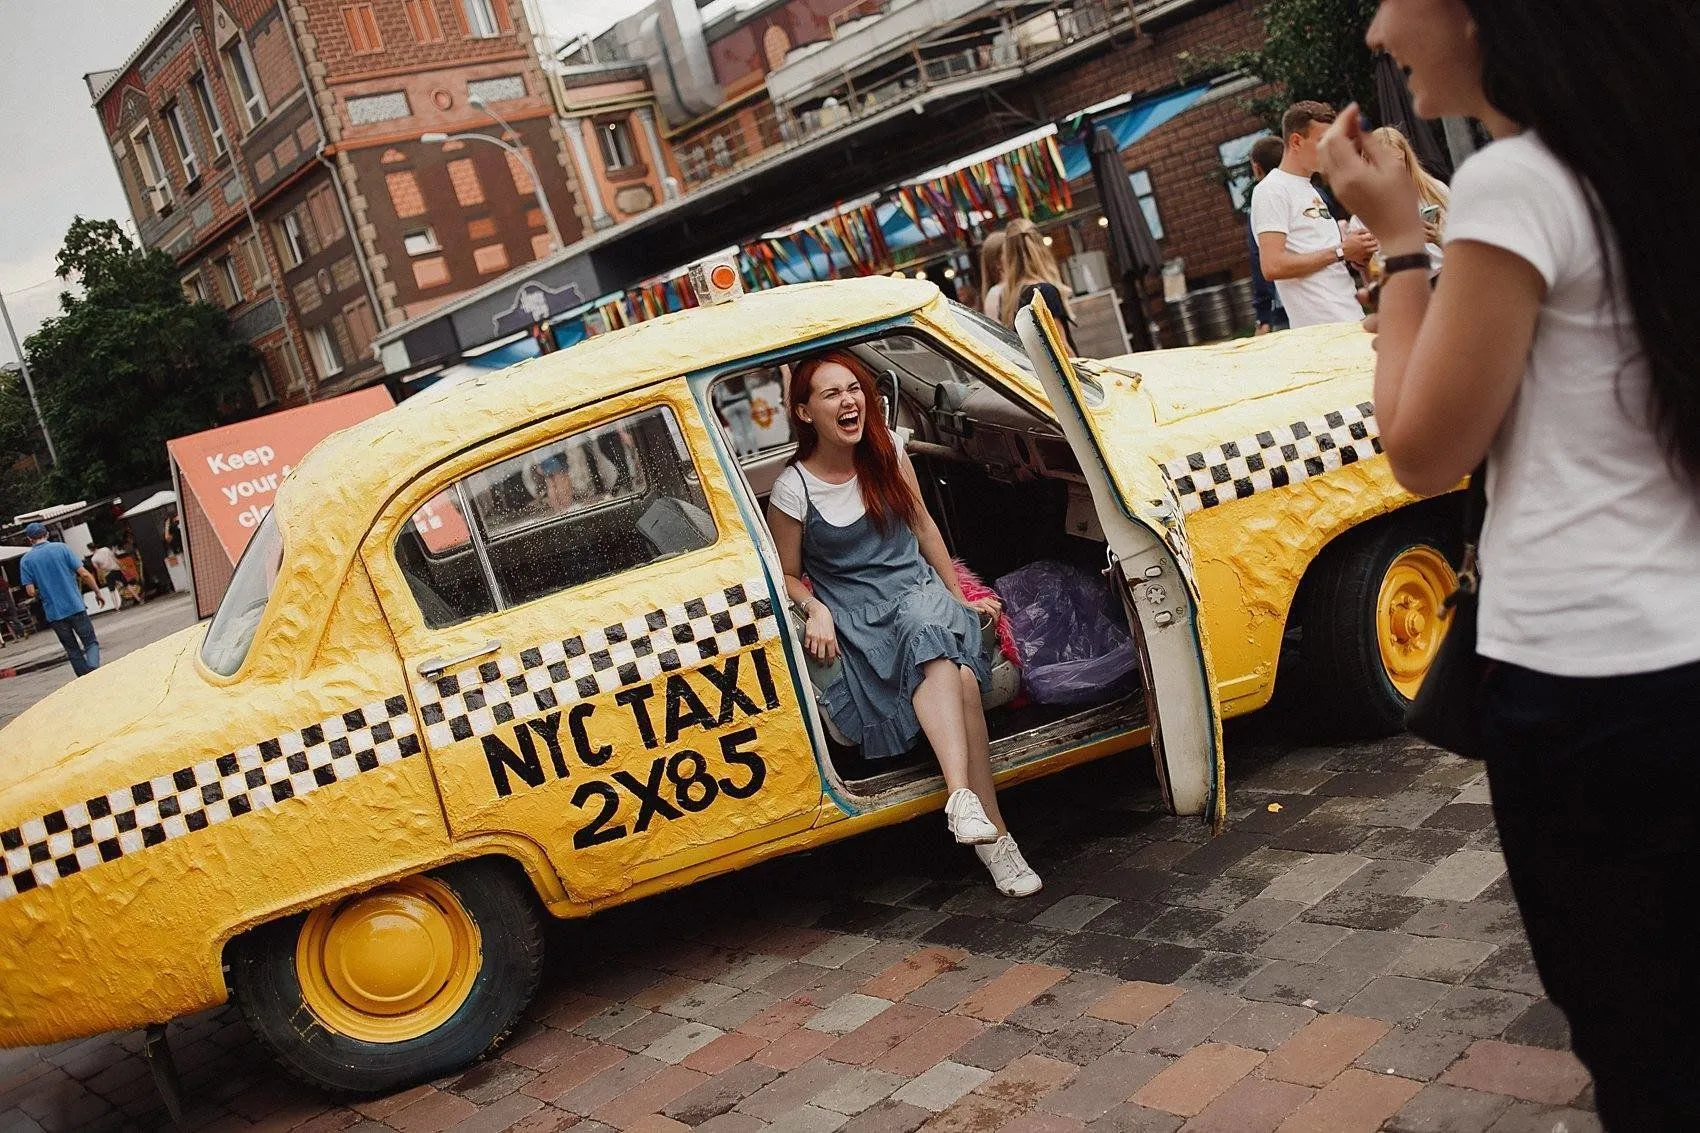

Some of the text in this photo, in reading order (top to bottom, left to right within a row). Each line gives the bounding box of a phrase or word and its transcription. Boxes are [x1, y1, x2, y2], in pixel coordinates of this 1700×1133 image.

[206, 446, 275, 475] Keep
[221, 473, 277, 505] your
[480, 647, 780, 798] NYC TAXI
[569, 727, 767, 850] 2X85
